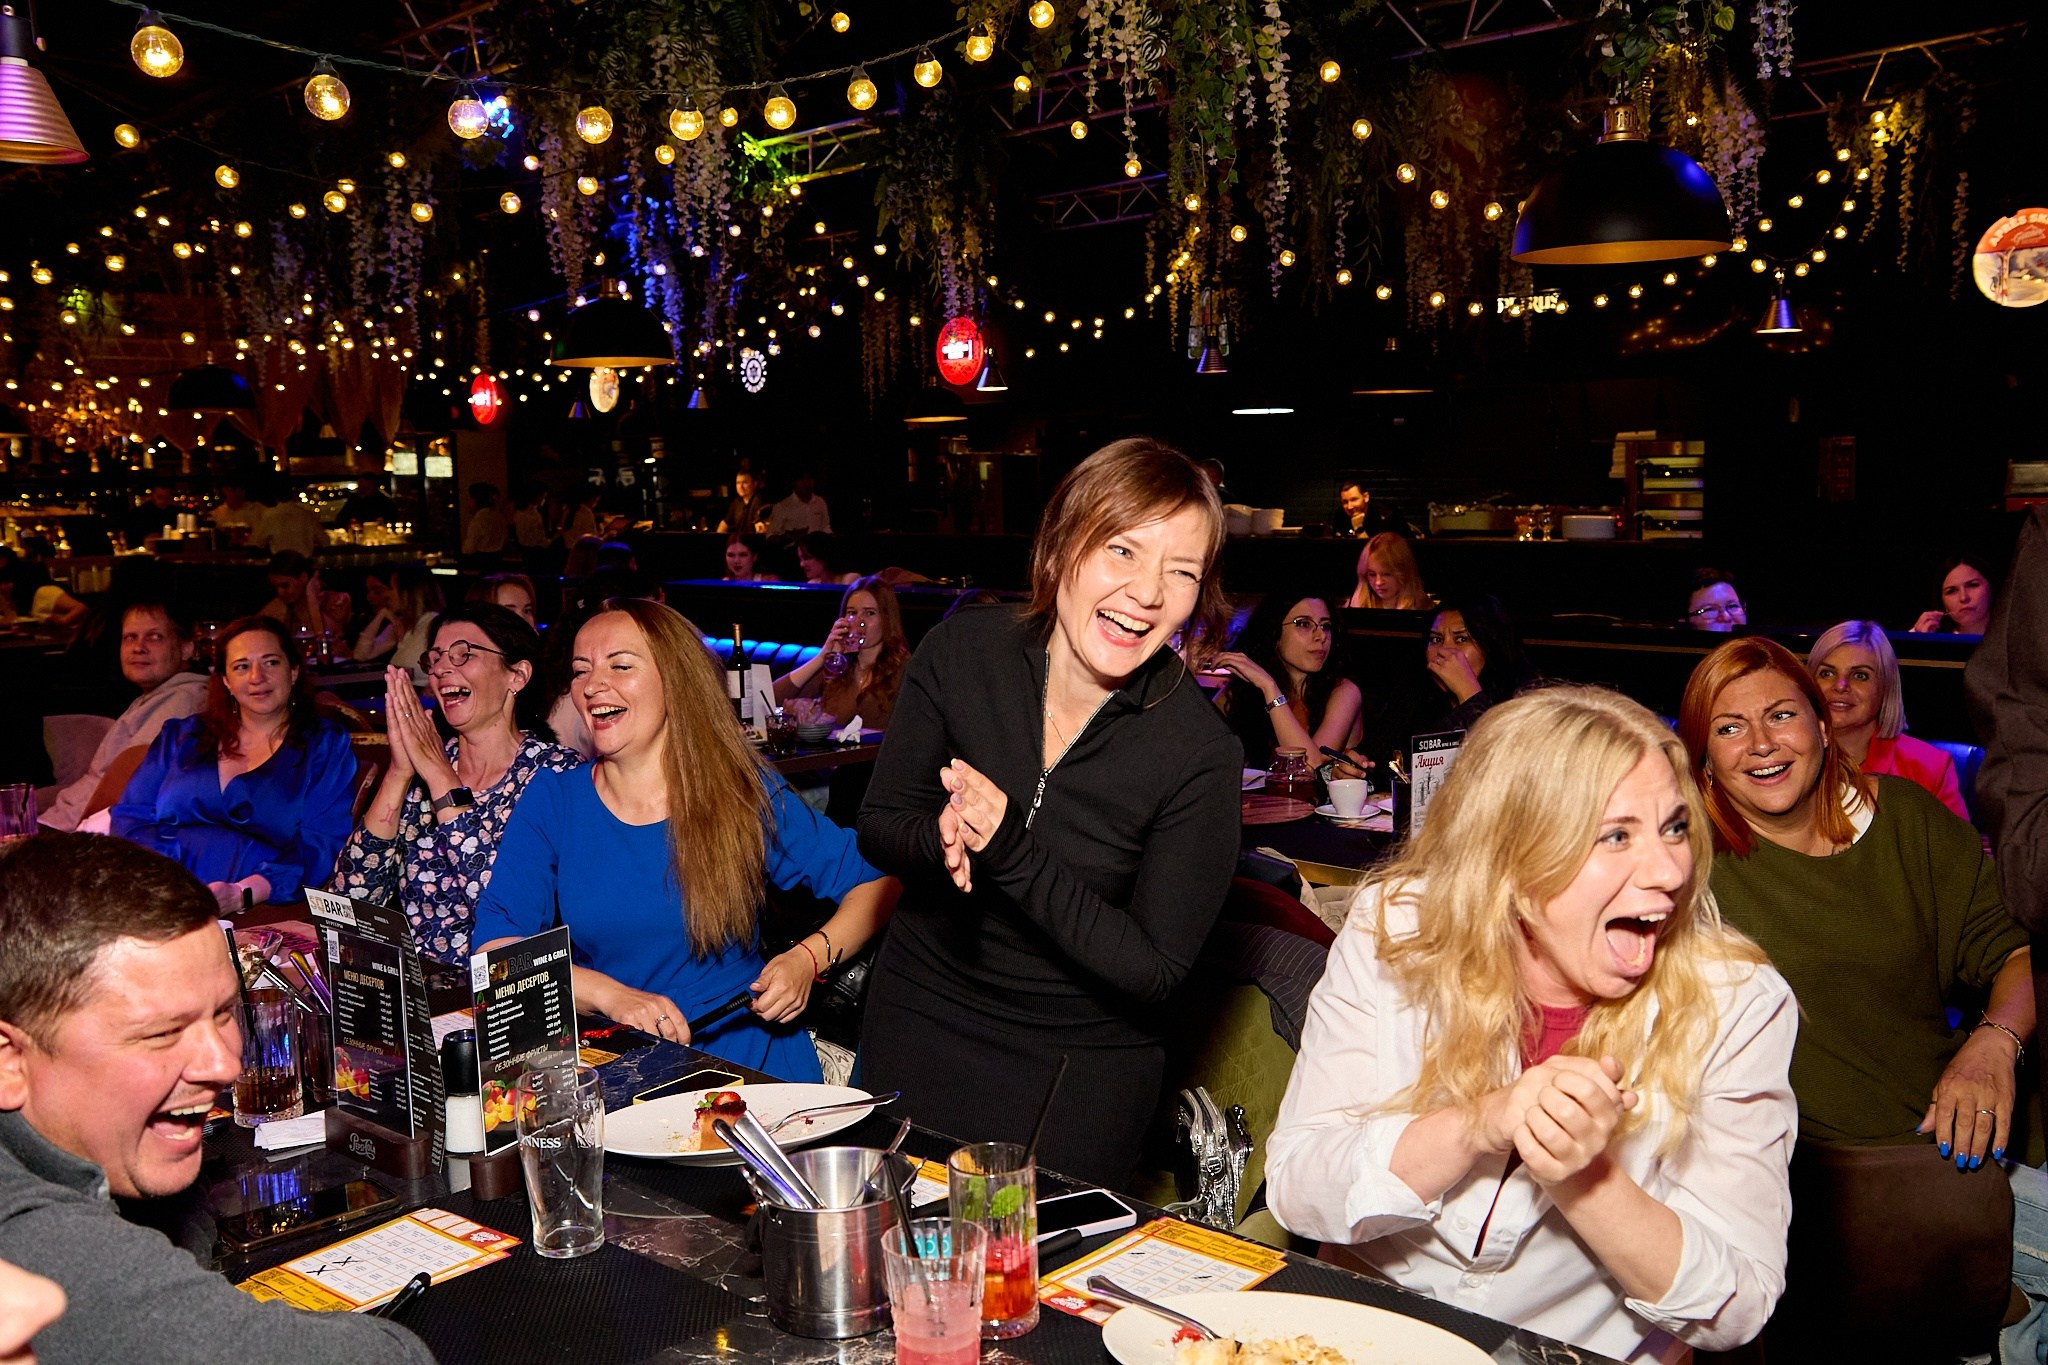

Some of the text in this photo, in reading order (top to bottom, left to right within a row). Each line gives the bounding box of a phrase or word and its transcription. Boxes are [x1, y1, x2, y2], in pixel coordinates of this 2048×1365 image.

[532, 955, 548, 967] WINE
[552, 948, 568, 960] GRILL
[494, 971, 550, 1000] МЕНЮ ДЕСЕРТОВ
[494, 1044, 549, 1073] СЕЗОННЫЕ ФРУКТЫ
